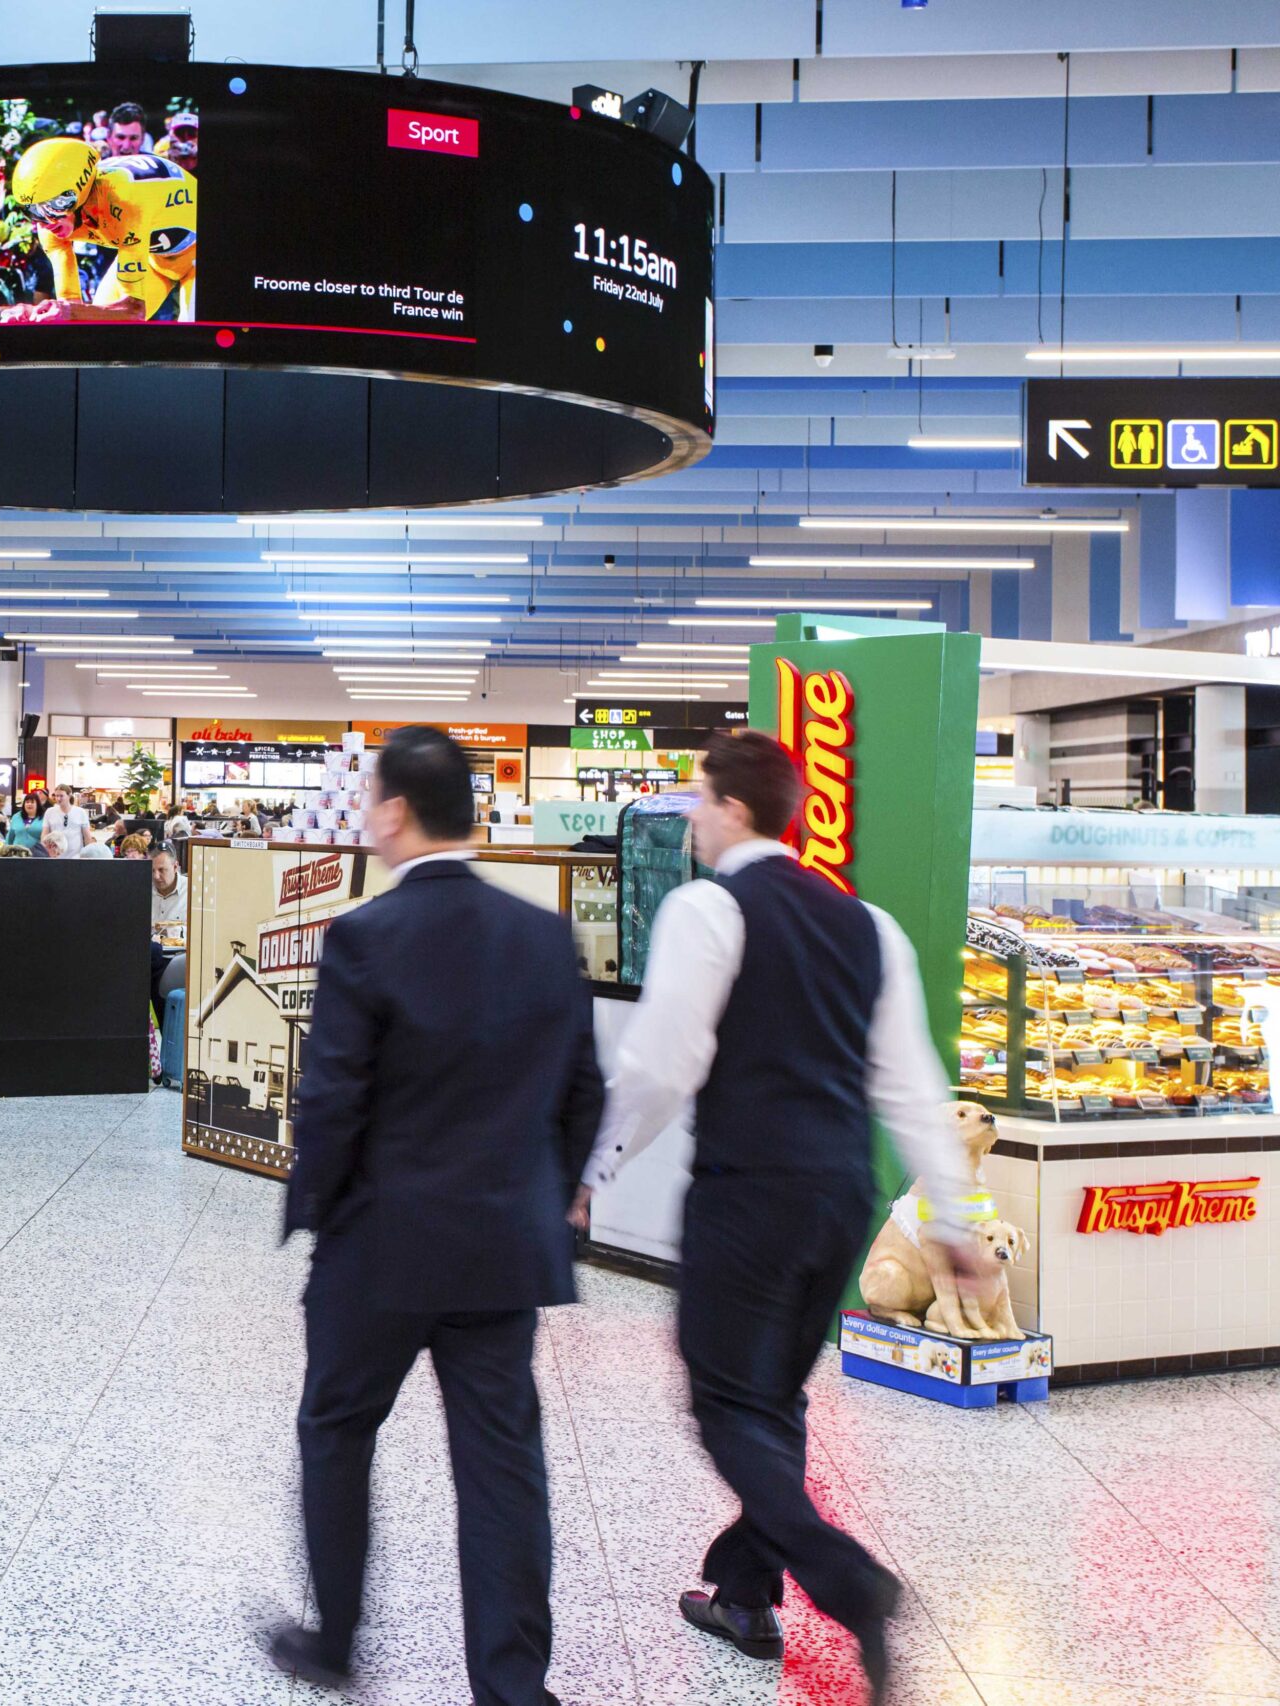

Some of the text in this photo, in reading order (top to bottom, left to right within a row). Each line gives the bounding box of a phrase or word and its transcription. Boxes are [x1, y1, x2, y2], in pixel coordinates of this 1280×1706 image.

[408, 121, 460, 145] Sport
[165, 188, 193, 208] LCL
[573, 222, 678, 289] 11:15am
[117, 261, 147, 273] LCL
[254, 276, 464, 304] Froome closer to third Tour de
[593, 275, 664, 313] Friday 22nd July
[393, 302, 464, 321] France win
[724, 710, 746, 720] Gates
[480, 734, 507, 743] burgers
[592, 729, 626, 740] CHOP
[592, 739, 638, 749] SALADS
[233, 840, 265, 849] SWITCHBOARD
[1051, 825, 1257, 848] DOUGHNUTS & COFFEE
[1076, 1176, 1261, 1237] Krispy Kreme
[843, 1315, 919, 1345] Every dollar counts.
[972, 1347, 987, 1358] Every
[987, 1346, 1001, 1356] dollar
